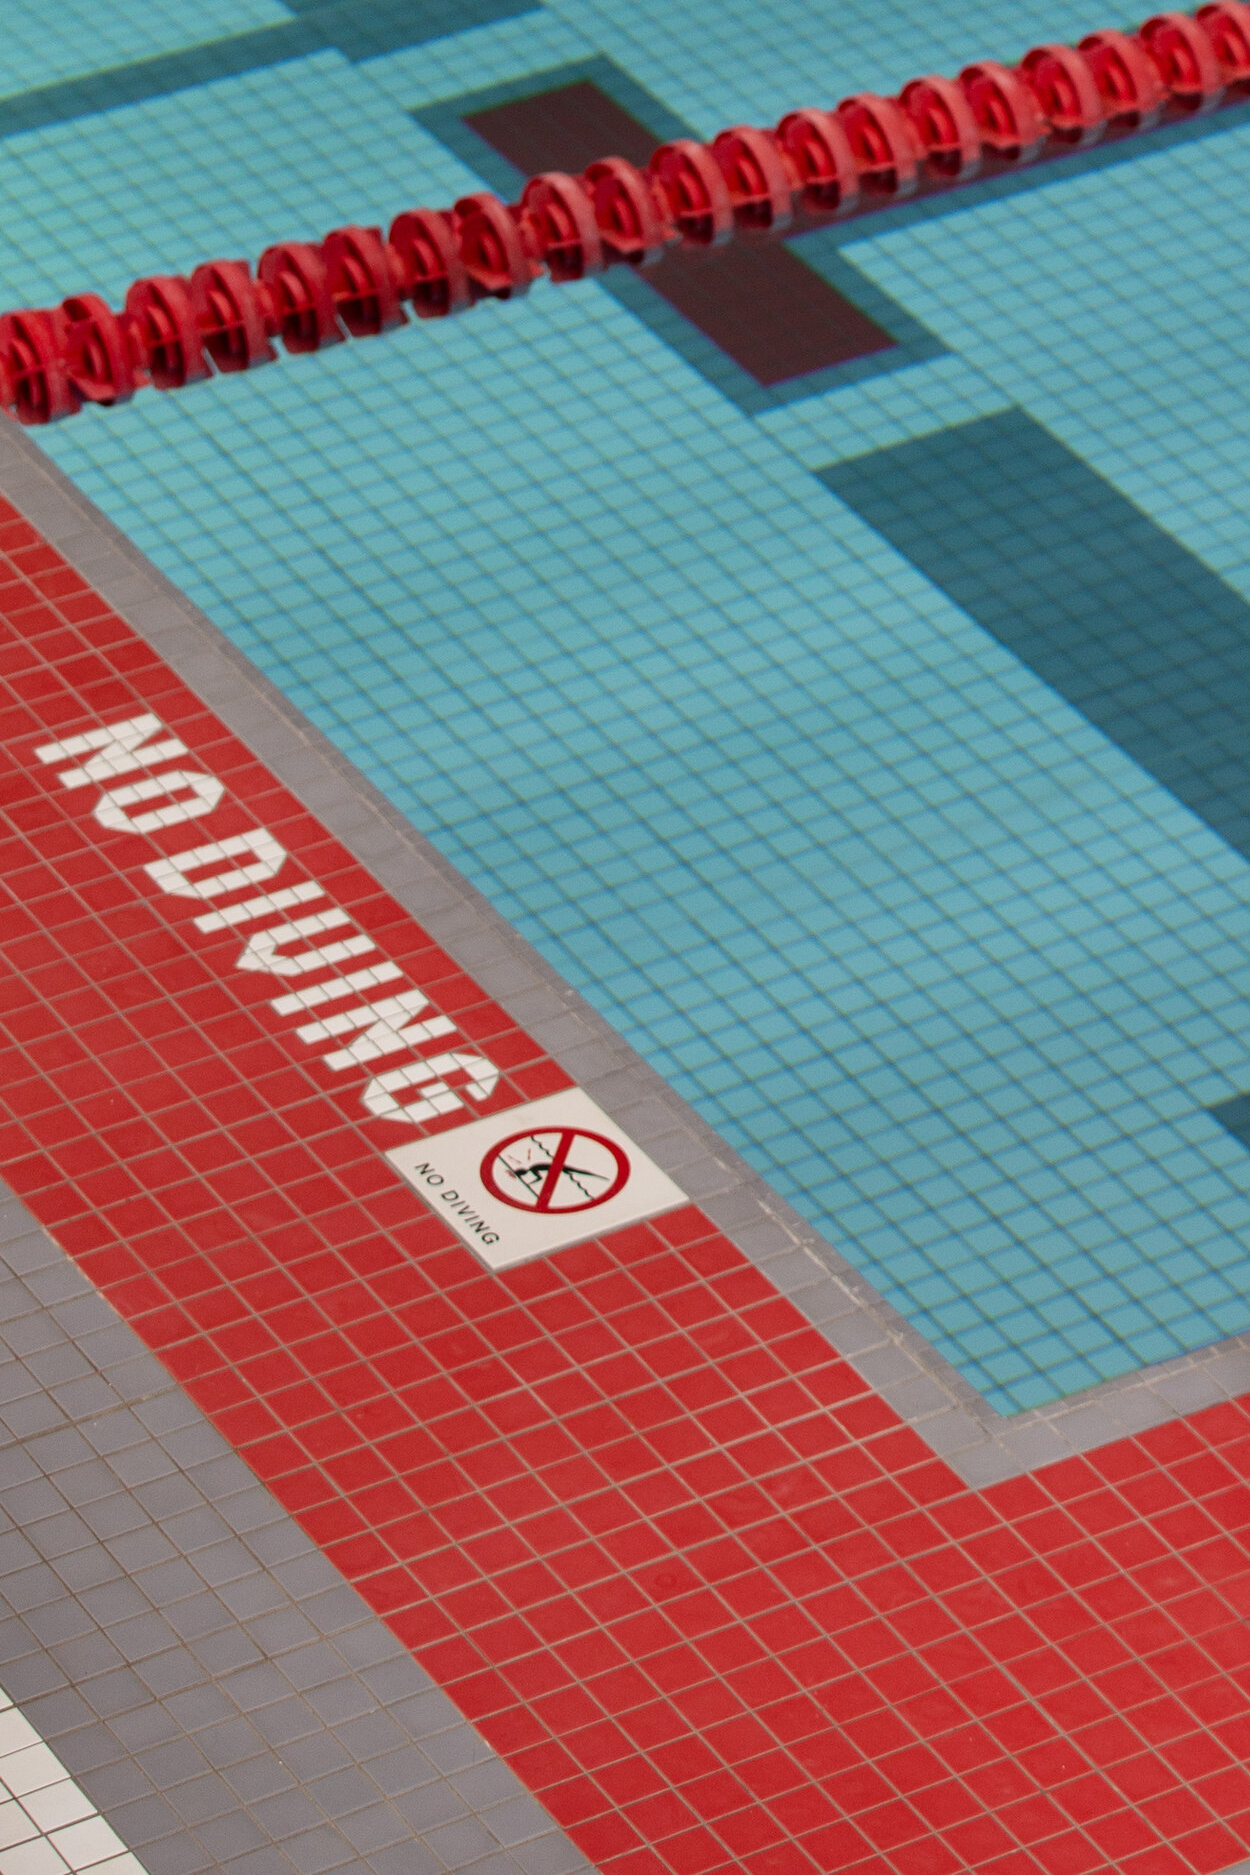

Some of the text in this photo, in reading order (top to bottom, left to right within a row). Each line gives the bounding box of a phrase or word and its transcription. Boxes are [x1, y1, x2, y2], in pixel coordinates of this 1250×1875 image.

[33, 712, 500, 1124] NO DIVING
[414, 1162, 500, 1245] NO DIVING
